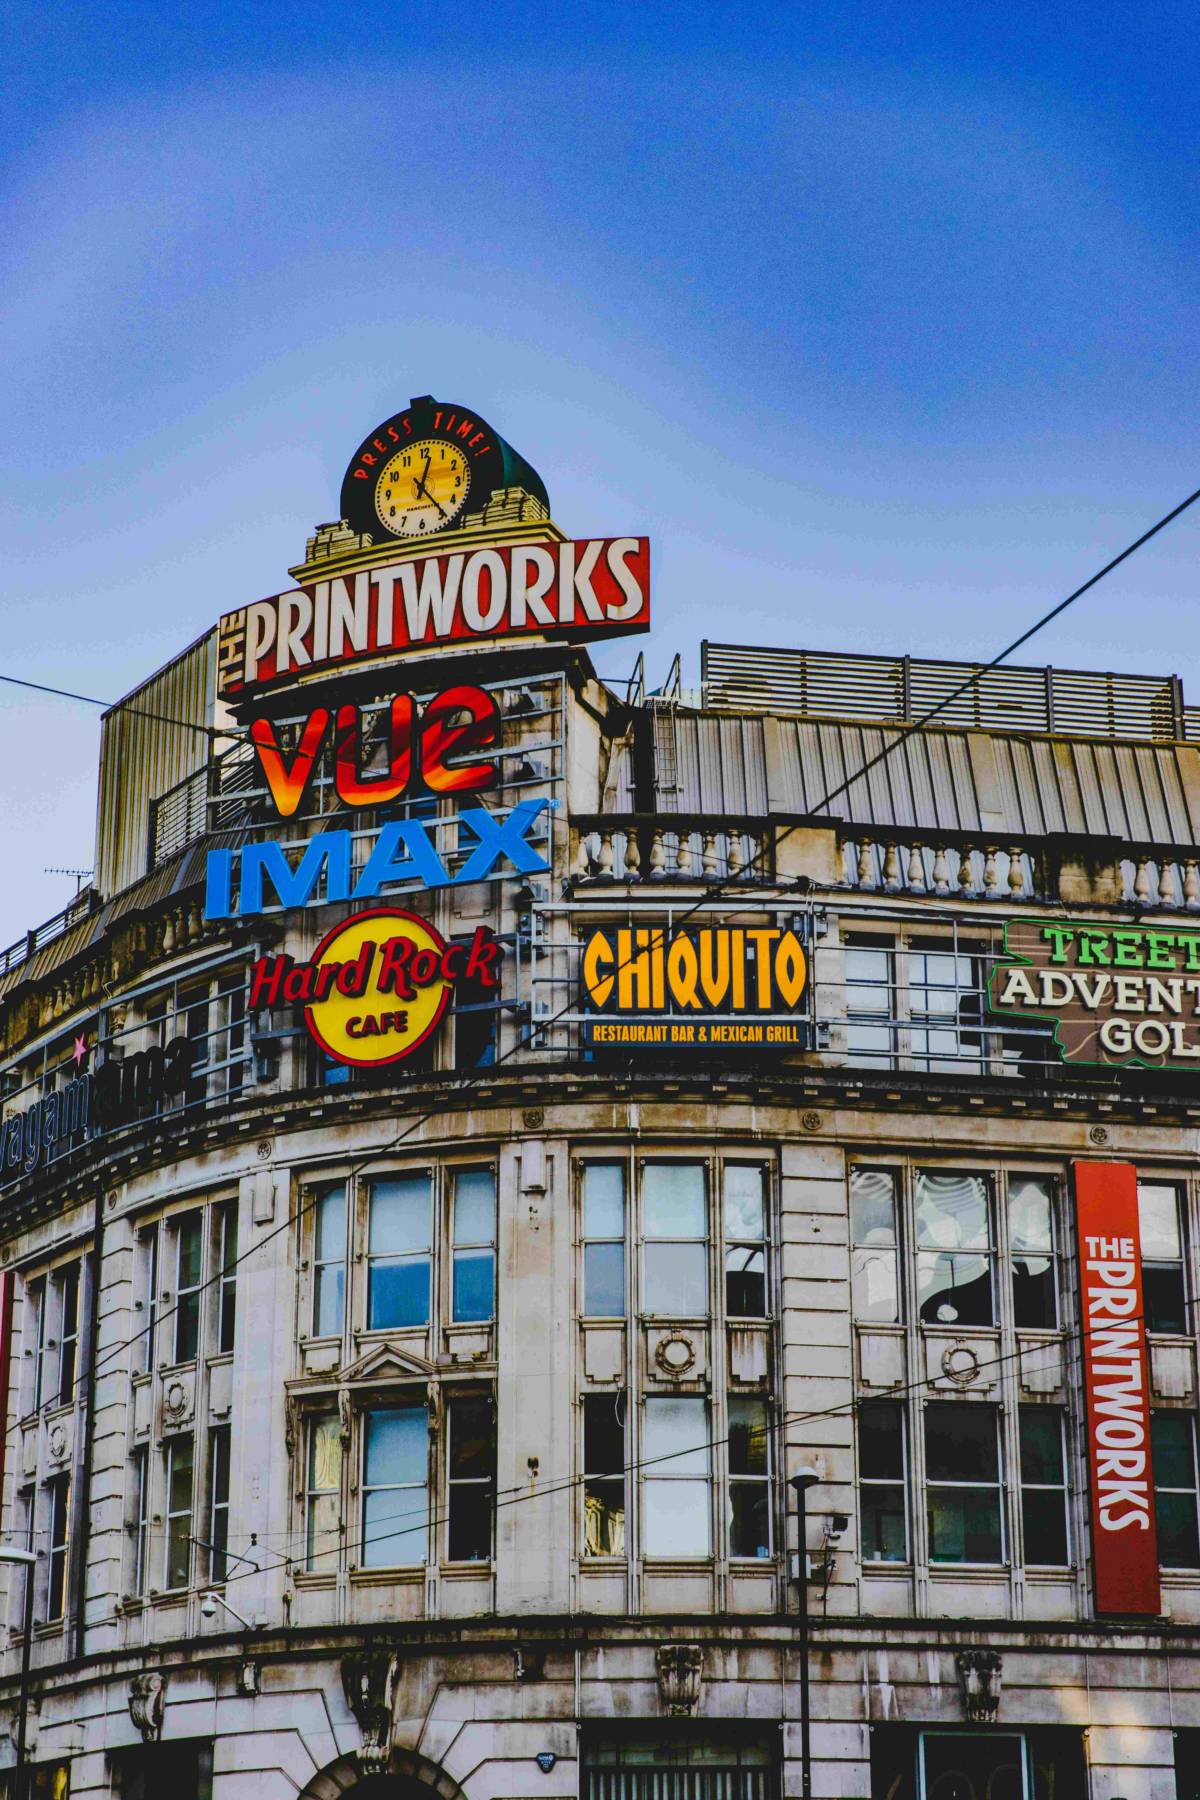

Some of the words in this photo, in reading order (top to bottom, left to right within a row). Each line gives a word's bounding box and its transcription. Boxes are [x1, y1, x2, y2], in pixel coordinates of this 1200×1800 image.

[353, 418, 412, 480] PRESS
[434, 411, 491, 457] TIME!
[420, 447, 430, 459] 12
[403, 456, 411, 467] 11
[451, 459, 457, 471] 2
[390, 471, 399, 483] 10
[455, 476, 461, 487] 3
[385, 490, 391, 501] 9
[450, 494, 456, 505] 4
[390, 506, 396, 517] 8
[406, 503, 439, 512] MANCHEST
[401, 516, 407, 527] 7
[419, 519, 425, 529] 6
[218, 607, 247, 694] THE
[244, 537, 641, 684] PRINTWORKS
[248, 940, 376, 1009] Hard
[377, 926, 500, 1000] Rock
[583, 929, 807, 1009] CHIQUITO
[345, 1010, 408, 1039] CAFE
[593, 1024, 667, 1042] RESTAURANT
[671, 1024, 694, 1042] BAR
[698, 1026, 707, 1042] &
[711, 1025, 762, 1042] MEXICAN
[766, 1026, 799, 1043] GRILL
[1085, 1235, 1135, 1260] THE
[1086, 1259, 1150, 1532] PRINTWORKS
